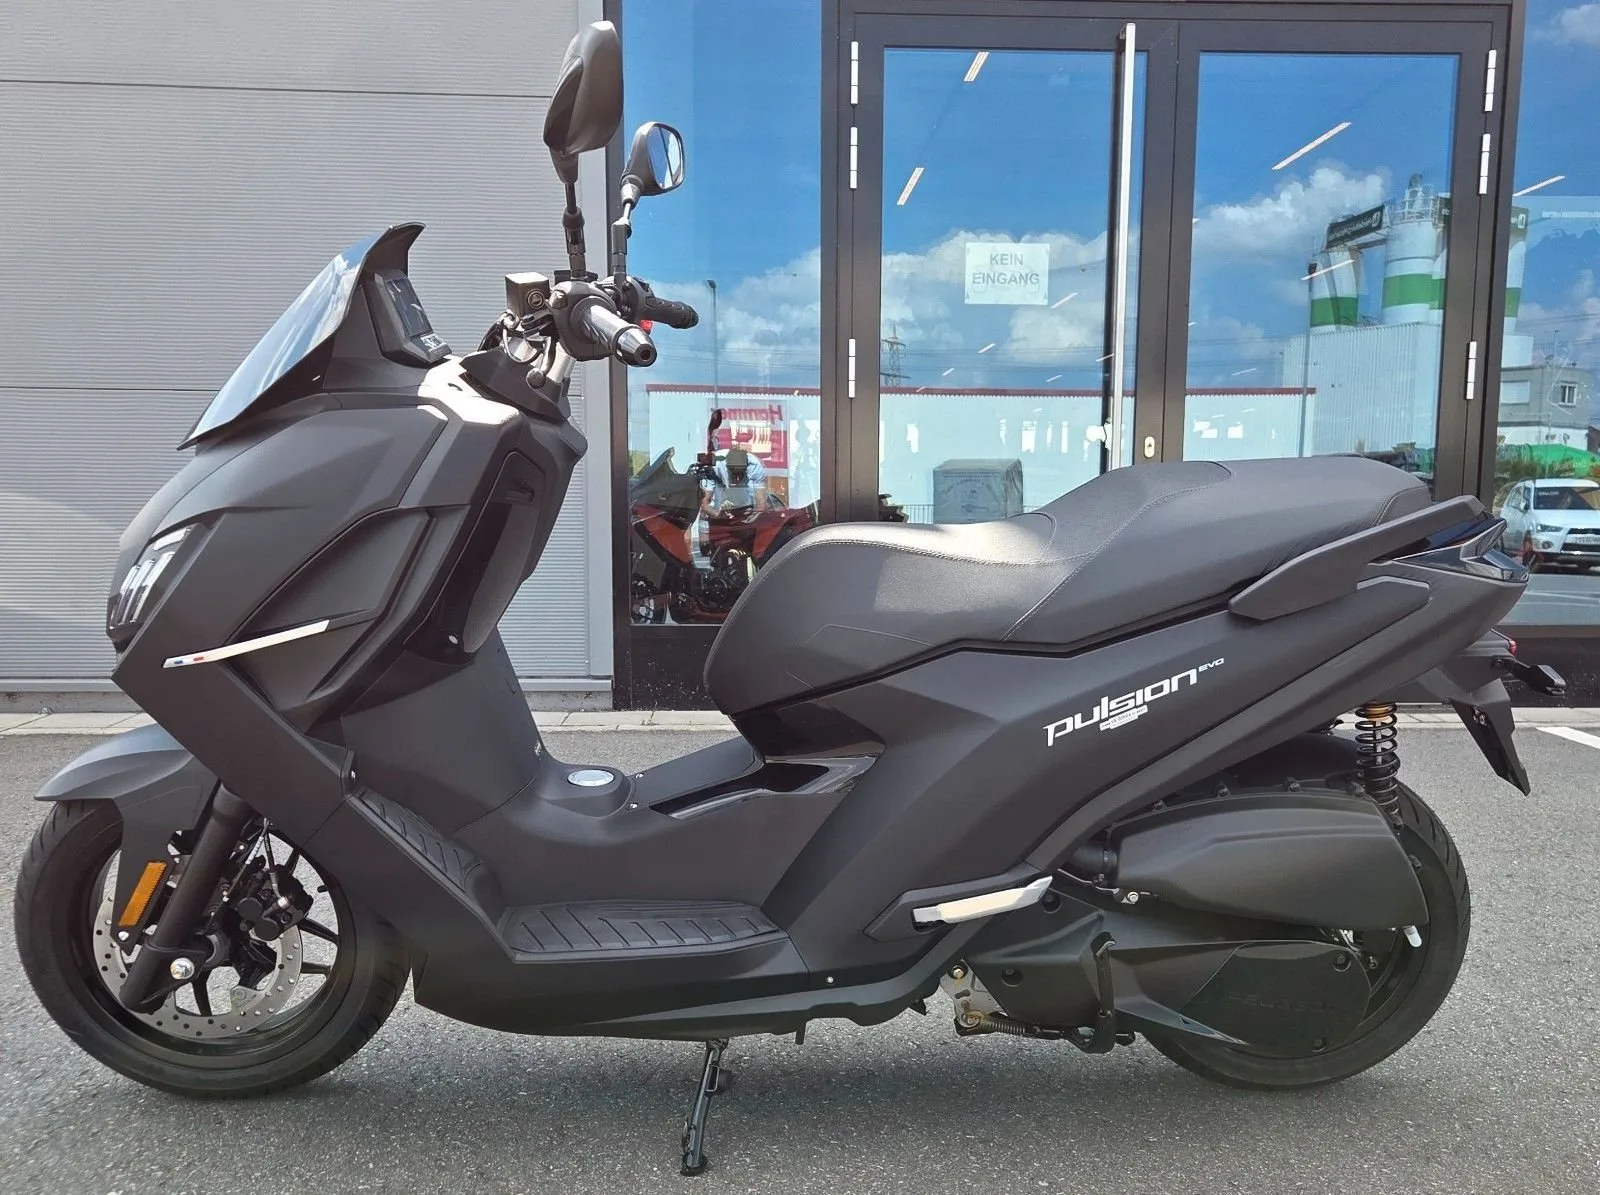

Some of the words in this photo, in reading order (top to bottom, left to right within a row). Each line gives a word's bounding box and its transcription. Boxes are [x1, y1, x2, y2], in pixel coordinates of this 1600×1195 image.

[990, 253, 1024, 266] KEIN
[972, 271, 1040, 285] EINGANG
[1198, 657, 1225, 673] EVO
